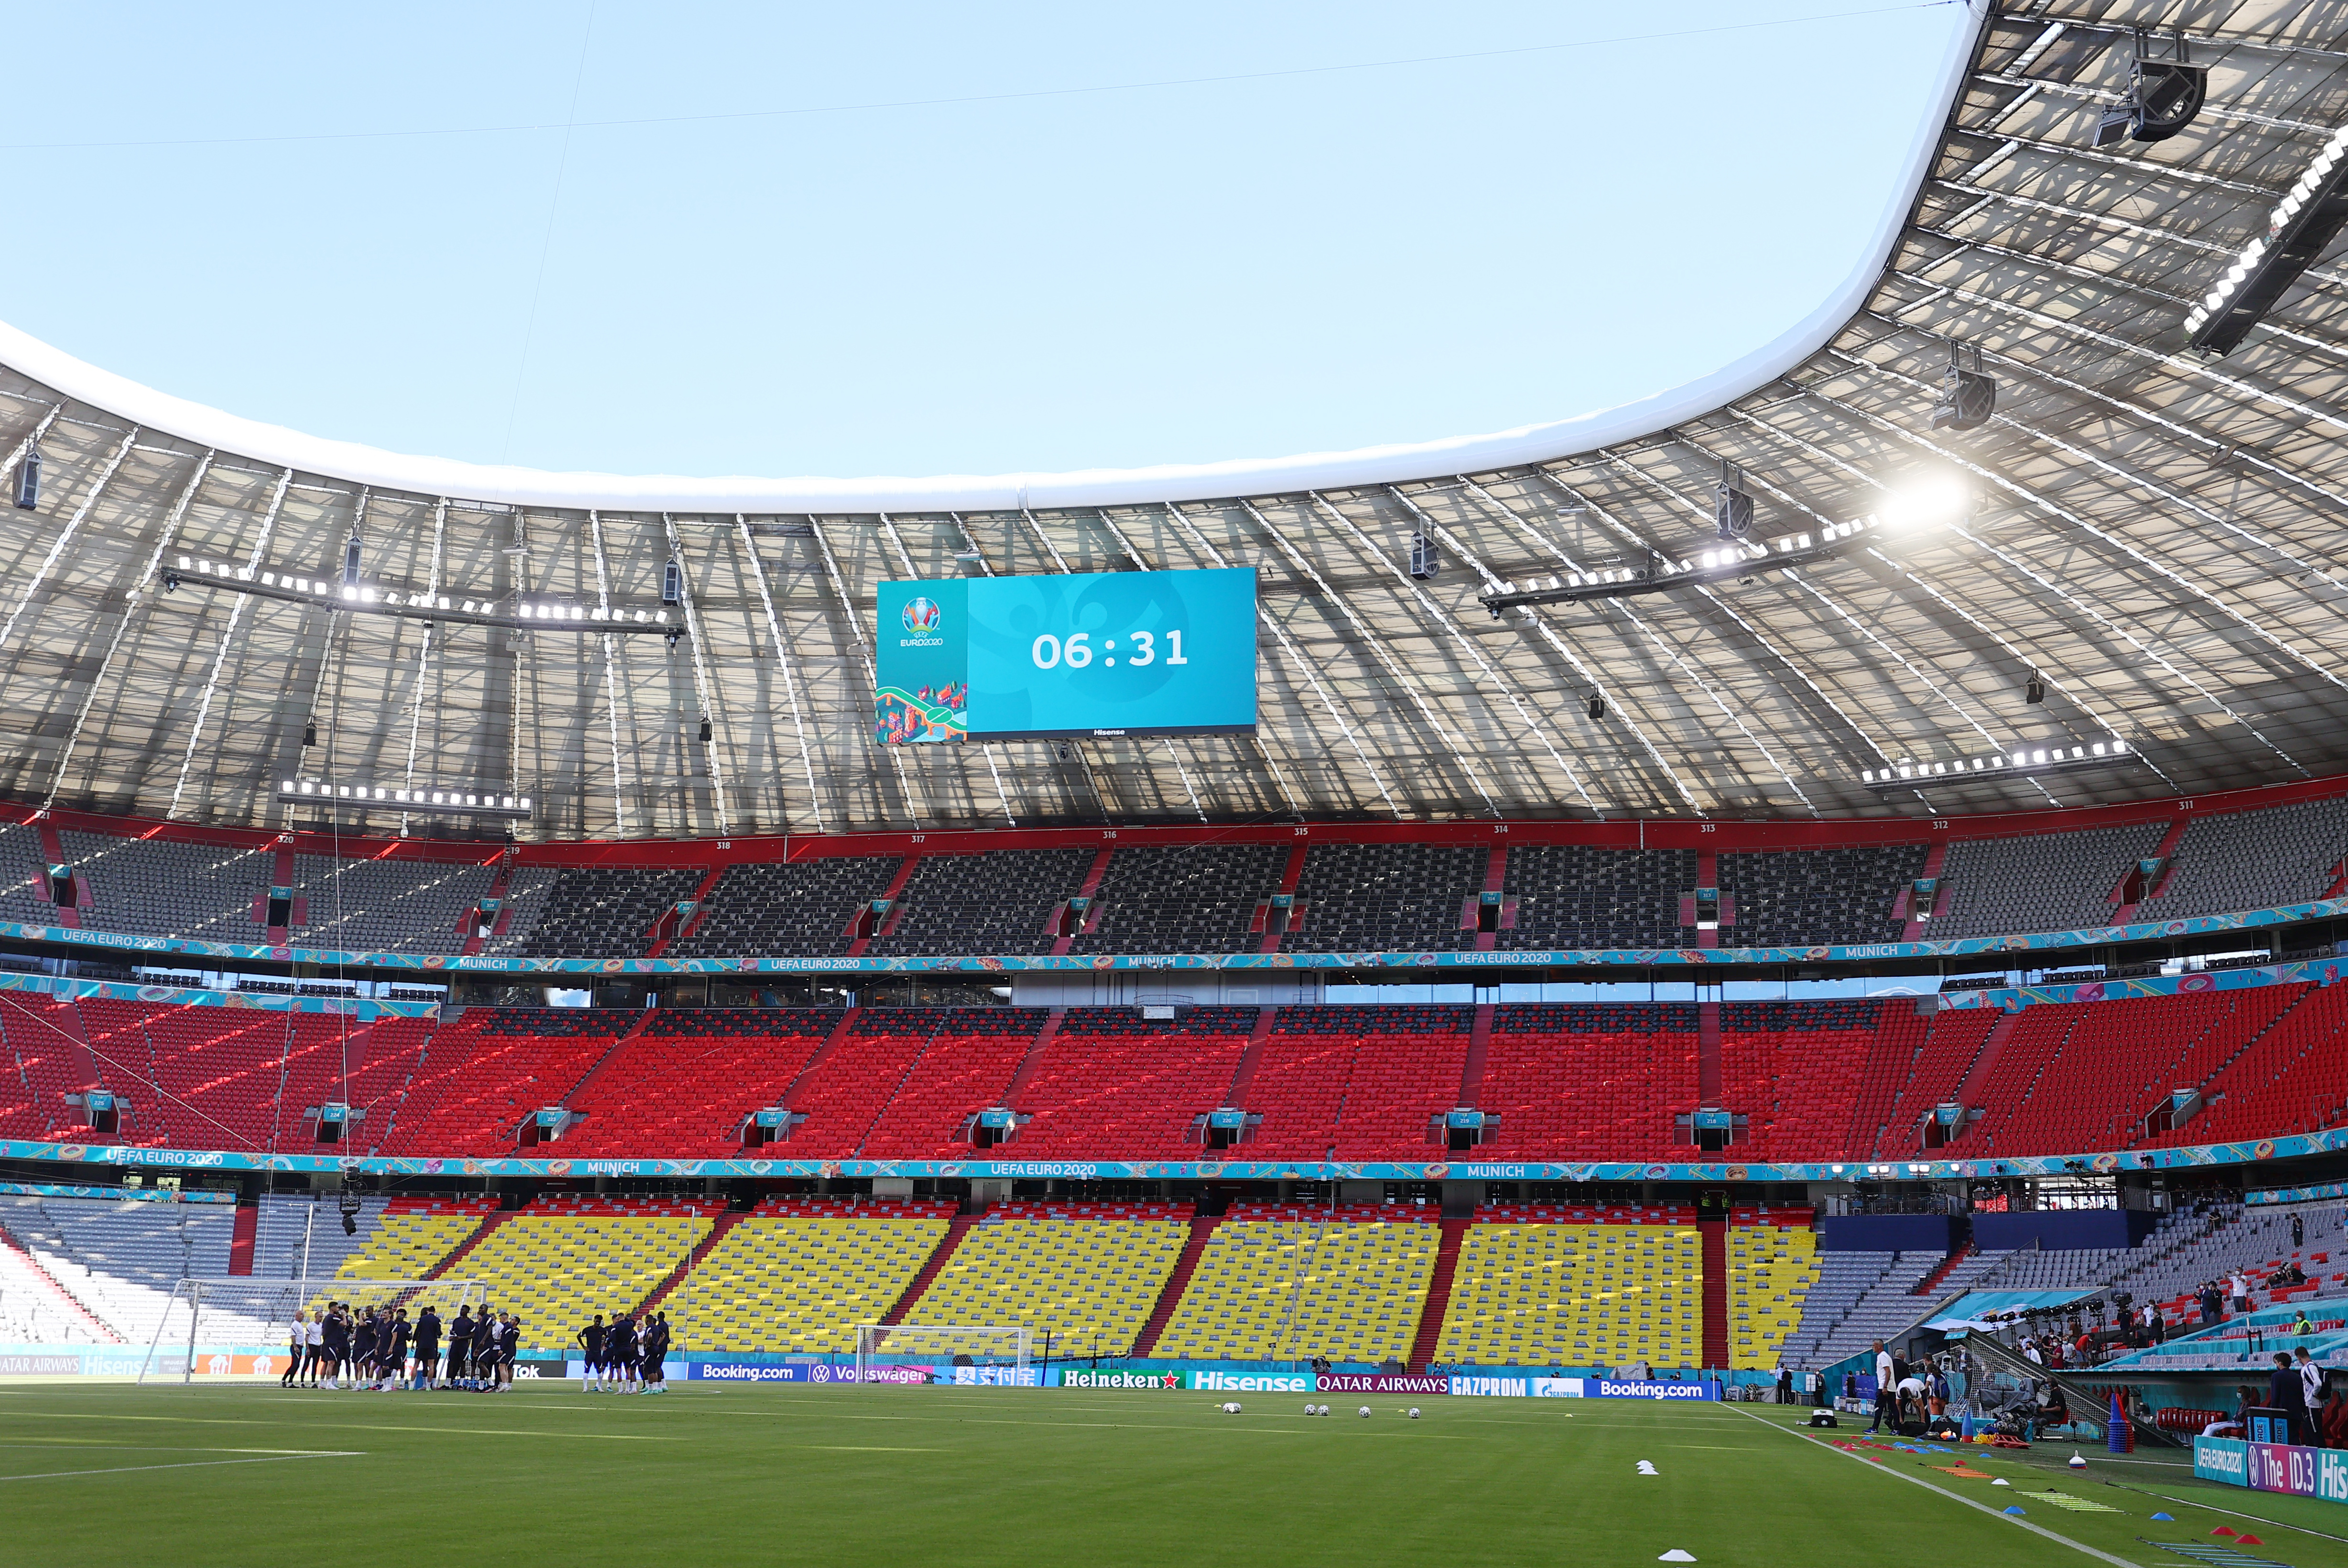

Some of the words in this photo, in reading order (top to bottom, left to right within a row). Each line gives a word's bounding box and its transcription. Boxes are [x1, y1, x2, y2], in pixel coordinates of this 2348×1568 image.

[2179, 800, 2193, 810] 311
[1294, 827, 1308, 835] 315
[1933, 821, 1948, 829] 312
[278, 835, 294, 843] 320
[716, 842, 731, 850] 318
[62, 930, 96, 943] UEFA
[98, 934, 132, 946] EURO
[134, 937, 166, 949] 2020
[1455, 953, 1486, 963] UEFA
[1487, 953, 1520, 963] EURO
[1521, 952, 1551, 962] 2020
[1846, 945, 1898, 957] MUNICH
[459, 958, 508, 969] MUNICH
[771, 960, 800, 969] UEFA
[801, 960, 831, 969] EURO
[832, 959, 860, 969] 2020
[1128, 957, 1176, 966] MUNICH
[107, 1149, 144, 1162] UEFA
[146, 1151, 185, 1164] EURO
[186, 1153, 223, 1165] 2020
[587, 1162, 639, 1173] MUNICH
[991, 1164, 1025, 1175] UEFA
[1027, 1164, 1062, 1175] EURO
[1063, 1164, 1096, 1175] 2020
[1468, 1165, 1525, 1177] MUNICH
[0, 1358, 30, 1372] ATAR
[32, 1357, 79, 1372] AIRWAYS
[84, 1356, 153, 1375] Hisense
[703, 1364, 793, 1381] Booking.com
[835, 1366, 927, 1384] Vokswagen
[1064, 1370, 1160, 1388] Heineken
[1195, 1372, 1306, 1392] Hisense
[1316, 1376, 1373, 1391] QATAR
[1376, 1377, 1448, 1392] AIRWAYS
[1452, 1377, 1526, 1397] GAZPROM
[1601, 1381, 1702, 1400] Booking.com
[2198, 1447, 2212, 1469] UEFA
[2212, 1449, 2227, 1471] EURO
[2227, 1451, 2241, 1473] 2020
[2262, 1449, 2283, 1488] The
[2289, 1451, 2314, 1492] ID.3
